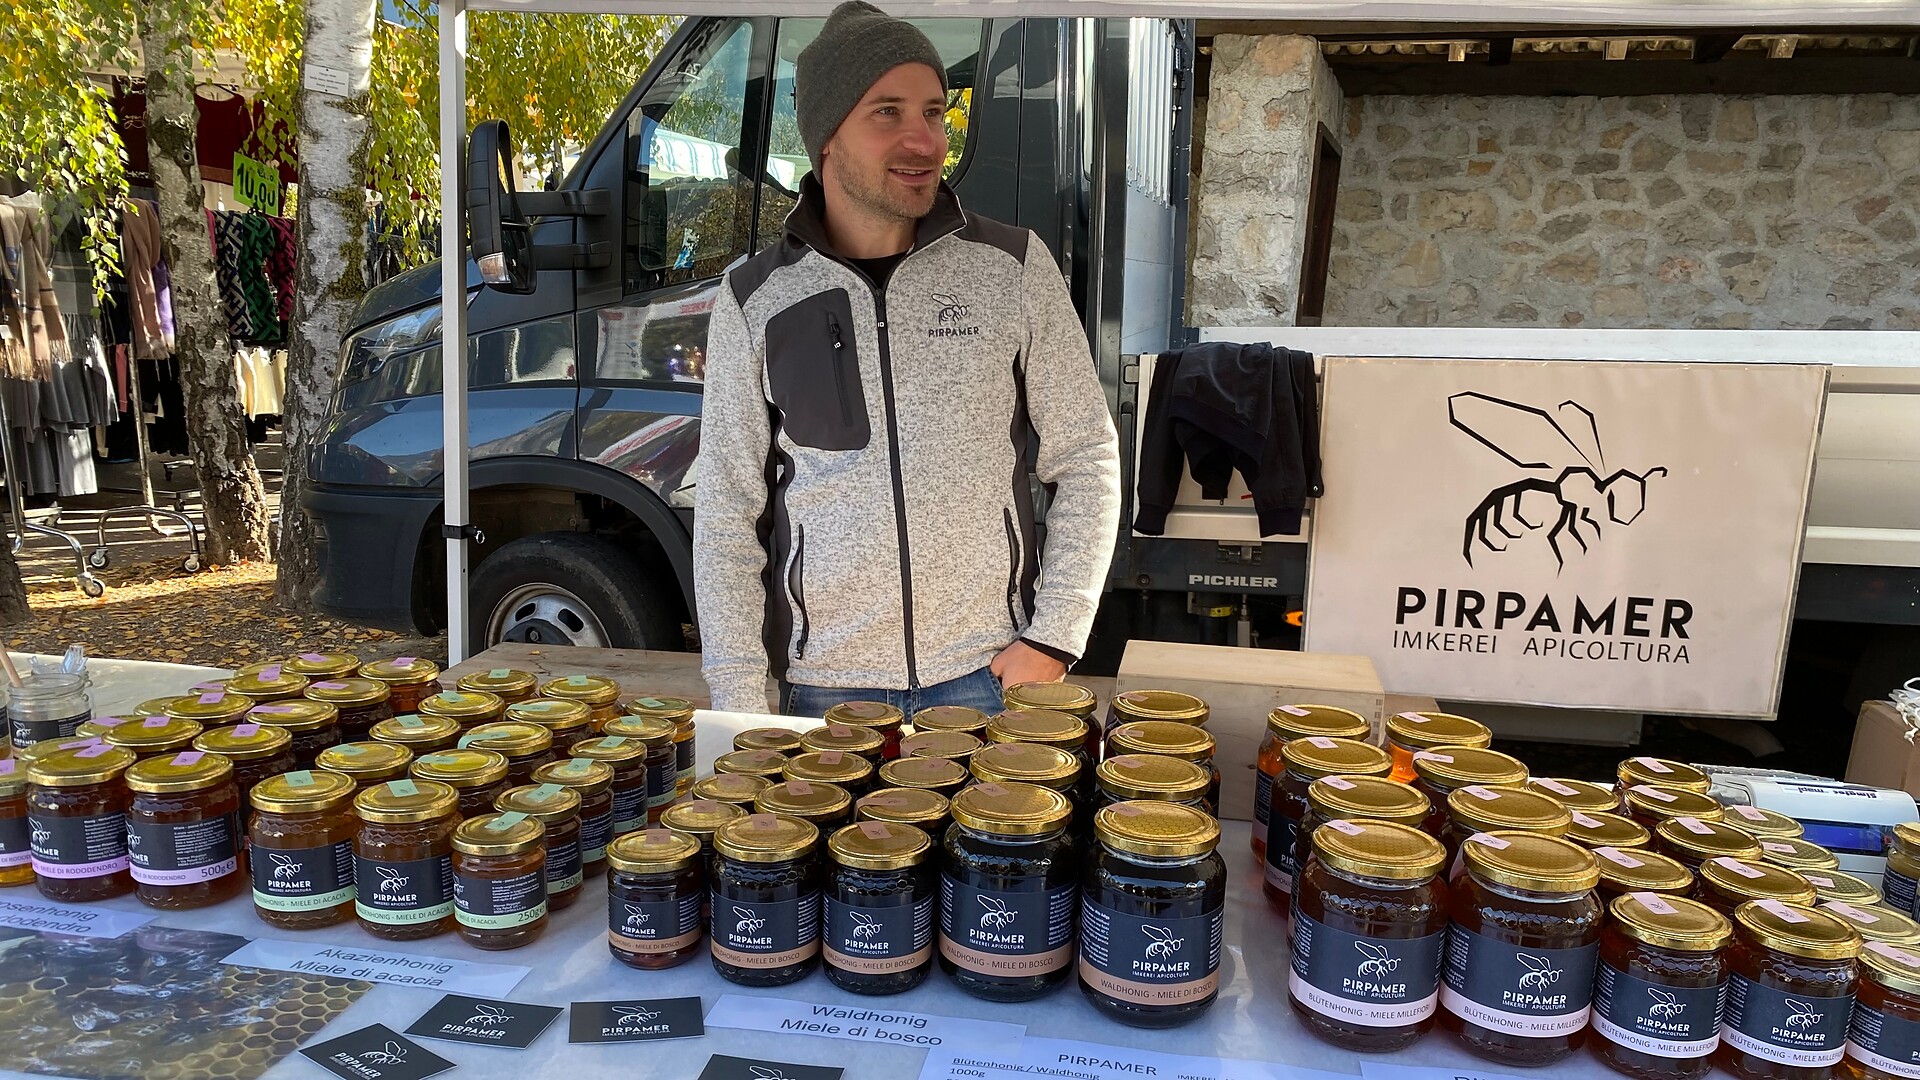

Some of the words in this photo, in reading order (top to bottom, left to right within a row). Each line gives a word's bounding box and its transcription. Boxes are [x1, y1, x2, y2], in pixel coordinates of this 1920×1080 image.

[928, 327, 980, 337] PIRPAMER
[1189, 575, 1278, 588] PICHLER
[1395, 587, 1694, 640] PIRPAMER
[1393, 630, 1498, 654] IMKEREI
[1523, 637, 1691, 665] APICOLTURA
[66, 862, 118, 874] RODODENDRO
[268, 880, 311, 888] PIRPAMER
[323, 892, 347, 903] ACACIA
[374, 893, 417, 901] PIRPAMER
[428, 906, 450, 917] ACACIA
[518, 909, 539, 922] 250g
[621, 925, 655, 935] PIRPAMER
[970, 928, 1025, 944] PIRPAMER
[729, 933, 772, 945] PIRPAMER
[845, 938, 889, 950] PIRPAMER
[314, 949, 453, 974] Akazienhonig
[778, 952, 799, 962] BOSCO
[895, 957, 915, 967] BOSCO
[946, 945, 985, 966] WALDHONIG
[991, 960, 1016, 969] MIELE
[1018, 961, 1027, 969] DI
[1029, 957, 1053, 968] BOSCO
[1132, 960, 1190, 972] PIRPAMER
[289, 960, 347, 974] Miele
[351, 968, 374, 978] di
[374, 970, 443, 987] acacia
[1100, 978, 1150, 998] WALDHONIG
[1157, 990, 1181, 999] MIELE
[1193, 981, 1213, 994] BOSCO
[1342, 987, 1366, 996] IMKEREI
[1343, 977, 1406, 993] PIRPAMER
[1503, 990, 1566, 1004] PIRPAMER
[1308, 992, 1363, 1017] BLÜTENHONIG
[1370, 1010, 1395, 1019] MIELE
[1396, 1004, 1431, 1018] MILLEFIORI
[1502, 1000, 1527, 1009] IMKEREI
[813, 1005, 928, 1029] Waldhonig
[1464, 1005, 1523, 1029] BLÜTENHONIG
[1531, 1022, 1555, 1031] MIELE
[442, 1024, 506, 1037] PIRPAMER
[602, 1025, 670, 1034] PIRPAMER
[1636, 1016, 1690, 1032] PIRPAMER
[780, 1019, 841, 1034] Miele
[848, 1026, 868, 1037] di
[874, 1028, 943, 1046] bosco
[1601, 1021, 1650, 1048] BLÜTENHONIG
[1657, 1044, 1681, 1052] MIELE
[1657, 1029, 1689, 1037] APICOLTURA
[1772, 1026, 1825, 1042] PIRPAMER
[1729, 1032, 1786, 1059] BLÜTENHONIG
[1793, 1053, 1816, 1062] MIELE
[335, 1052, 382, 1078] PIRPAMER
[952, 1057, 1024, 1072] Blütenhonig
[1036, 1066, 1100, 1080] Waldhonig
[1058, 1054, 1157, 1076] PIRPAMER
[950, 1068, 985, 1078] 1000g
